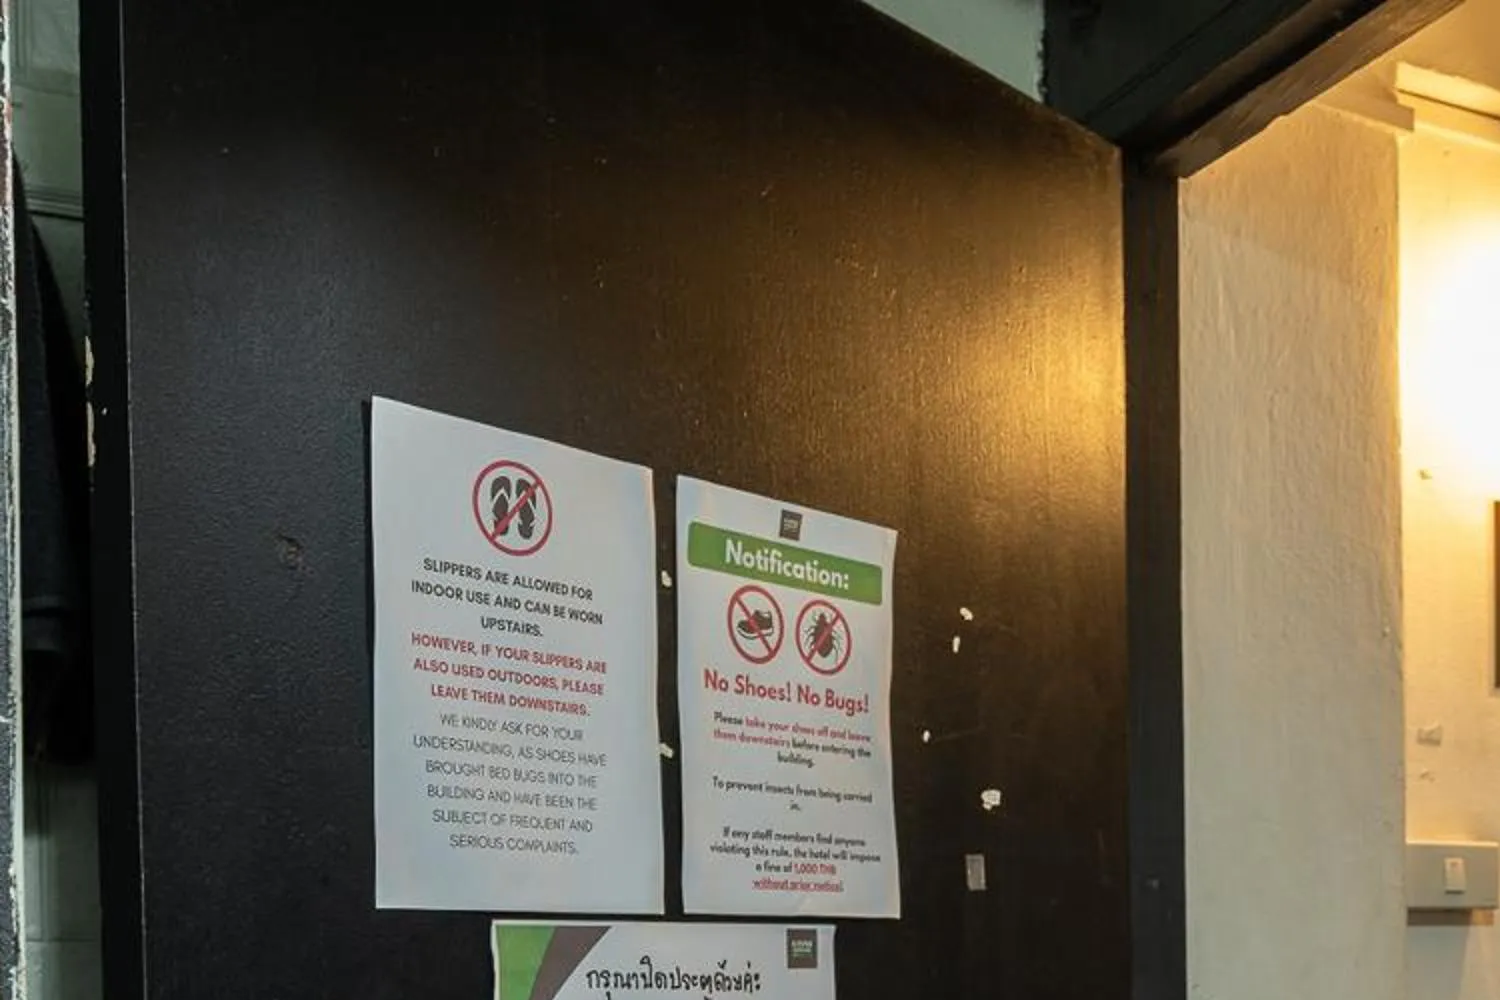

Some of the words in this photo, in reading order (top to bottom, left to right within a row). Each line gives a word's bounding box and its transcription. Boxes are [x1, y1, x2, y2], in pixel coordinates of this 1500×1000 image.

[424, 558, 482, 580] SLIPPERS
[485, 570, 509, 584] ARE
[513, 576, 568, 594] ALLOWED
[572, 587, 593, 600] FOR
[726, 539, 849, 590] Notification:
[411, 580, 463, 601] INDOOR
[466, 590, 490, 605] USE
[494, 596, 521, 610] AND
[524, 600, 551, 616] CAN
[553, 606, 566, 618] BE
[568, 609, 603, 624] WORN
[481, 616, 543, 636] UPSTAIRS.
[704, 669, 728, 692] No
[734, 674, 791, 702] Shoes!
[798, 684, 820, 705] No
[825, 688, 869, 717] Bugs!
